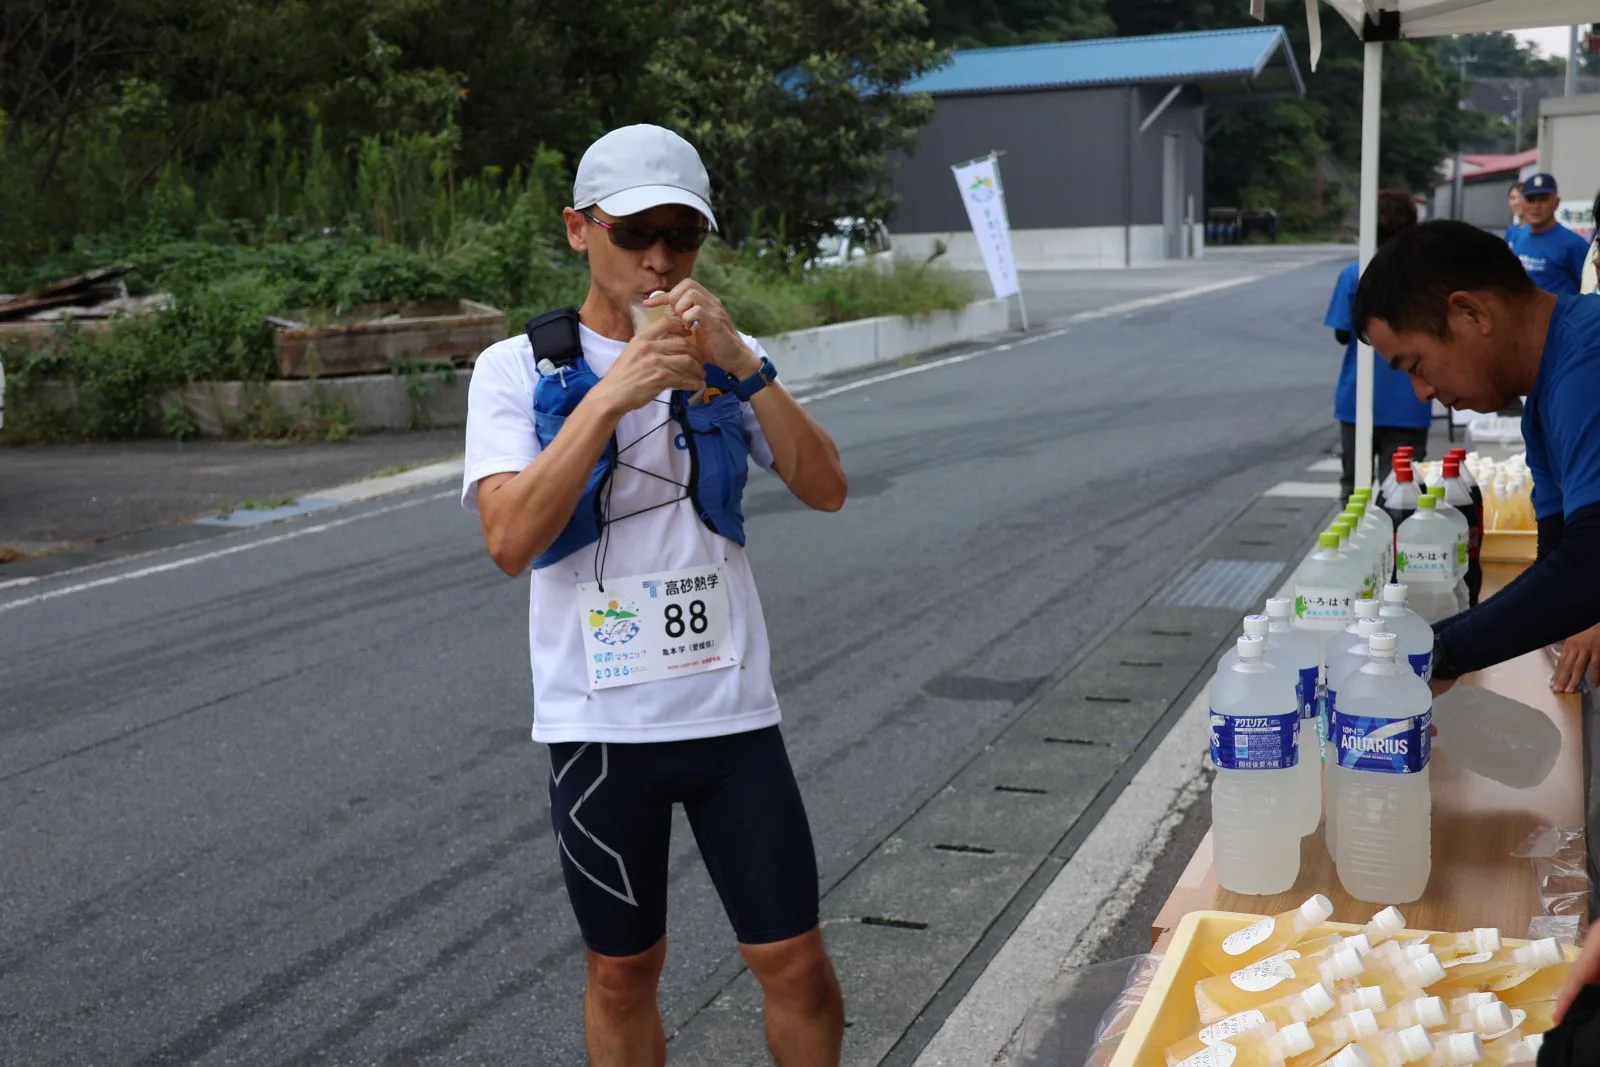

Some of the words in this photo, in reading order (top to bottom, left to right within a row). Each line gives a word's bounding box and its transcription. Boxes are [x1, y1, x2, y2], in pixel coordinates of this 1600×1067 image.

[664, 572, 719, 596] 高砂熱学
[664, 600, 709, 638] 88
[1233, 717, 1269, 728] アクエリアス
[1341, 734, 1409, 755] AQUARIUS
